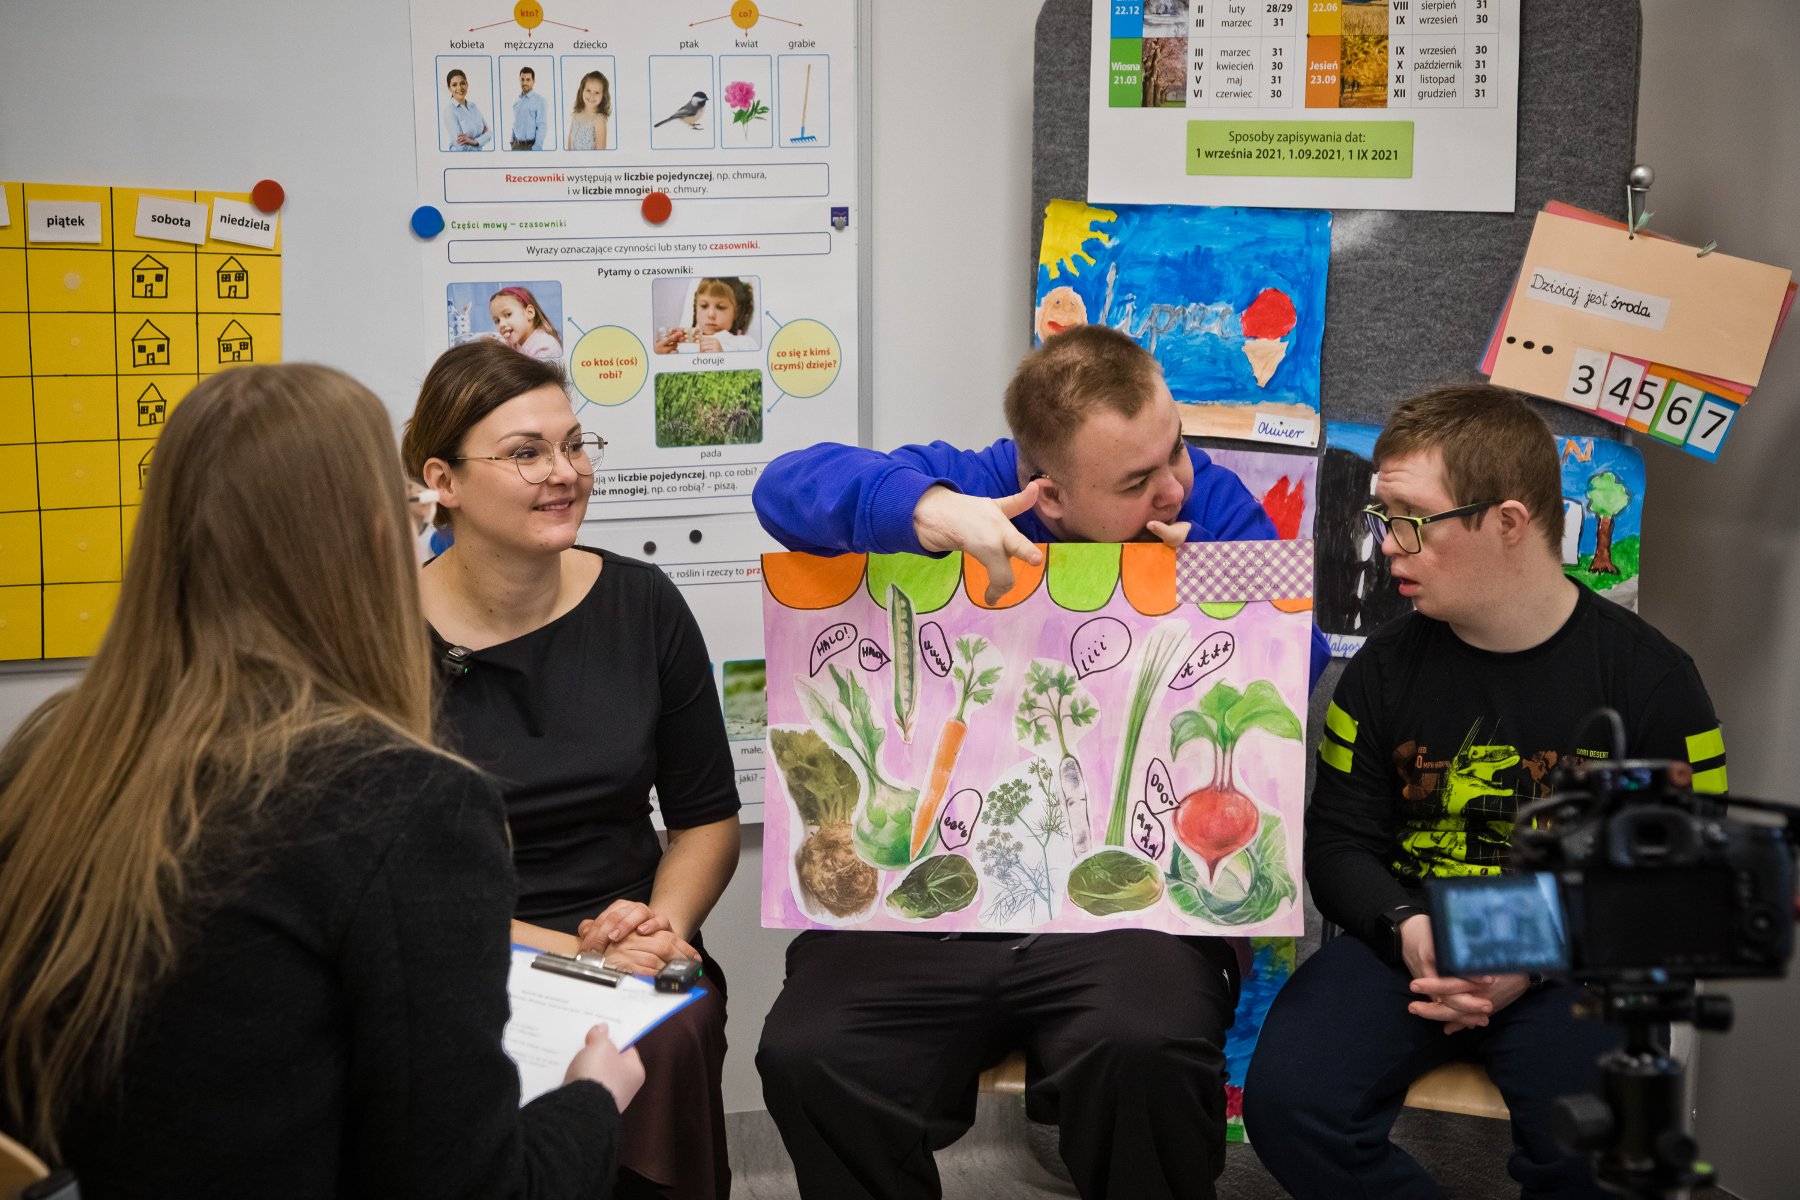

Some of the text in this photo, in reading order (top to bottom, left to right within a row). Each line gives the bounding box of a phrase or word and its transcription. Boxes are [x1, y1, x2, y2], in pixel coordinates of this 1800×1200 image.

[1115, 6, 1140, 15] 22.12
[1197, 4, 1293, 15] II luty 28/29
[1313, 4, 1338, 12] 22.06
[1393, 0, 1488, 12] VIII sierpień 31
[520, 8, 539, 18] kto?
[738, 9, 753, 18] co?
[1195, 19, 1204, 27] III
[1273, 18, 1284, 27] 31
[1395, 15, 1488, 24] IX wrzesień 30
[450, 39, 485, 49] kobieta
[504, 39, 554, 51] mężczyzna
[573, 39, 608, 49] dziecko
[679, 38, 700, 51] ptak
[735, 38, 759, 48] kwiat
[788, 38, 816, 50] grabie
[1194, 48, 1283, 57] III marzec 31
[1395, 45, 1488, 55] IX wrzesień 30
[1111, 62, 1140, 71] Wiosna
[1194, 61, 1283, 71] IV kwiecień 30
[1309, 60, 1338, 71] Jesień
[1397, 60, 1486, 71] X październik 31
[1113, 76, 1137, 85] 21.03
[1195, 75, 1282, 86] V maj 31
[1310, 75, 1337, 84] 23.09
[1395, 74, 1487, 85] XI listopad 30
[1193, 89, 1282, 99] VI czerwiec 30
[1393, 88, 1486, 100] XII grudzień 31
[1229, 130, 1366, 145] Sposoby zapisywania dat:
[1196, 148, 1399, 161] 1 września 2021, 1.09.2021, 1 IX 2021
[505, 170, 767, 184] Rzeczowniki występują w liczbie pojedynczej, np. chmura,
[572, 187, 581, 195] w
[582, 185, 612, 195] liczbie
[673, 183, 709, 195] chmury.
[46, 214, 85, 228] piątek
[150, 213, 191, 228] sobota
[219, 213, 270, 232] niedziela
[451, 220, 480, 231] Części
[483, 222, 508, 231] mowy
[519, 219, 567, 228] czasowniki
[526, 240, 761, 257] Wyrazy oznaczające czynności lub stany to czasowniki.
[597, 266, 632, 279] Pytamy
[641, 265, 694, 276] czasowniki:
[1530, 273, 1580, 305] Dzisiaj
[1584, 291, 1608, 309] jest
[776, 350, 788, 358] co
[789, 348, 801, 359] się
[809, 347, 831, 357] kimś
[581, 356, 638, 368] co ktoś (coś)
[692, 356, 725, 367] choruje
[770, 359, 837, 372] (czymś) dzieje?
[599, 370, 623, 380] robi?
[1572, 365, 1727, 440] 3 4 5 6 7
[700, 449, 722, 460] pada
[618, 472, 648, 482] liczbie
[650, 468, 708, 483] pojedynczej,
[709, 471, 723, 479] np.
[724, 470, 735, 478] co
[736, 467, 757, 476] robi?
[609, 484, 649, 497] mnogiej,
[651, 486, 664, 495] np.
[666, 485, 677, 493] co
[679, 482, 705, 493] robią?
[714, 481, 738, 491] piszą.
[676, 568, 700, 578] roślin
[706, 568, 733, 578] rzeczy
[736, 568, 745, 576] to
[816, 626, 850, 657] HALO!
[1589, 749, 1609, 759] DESERT
[738, 773, 758, 785] jaki?
